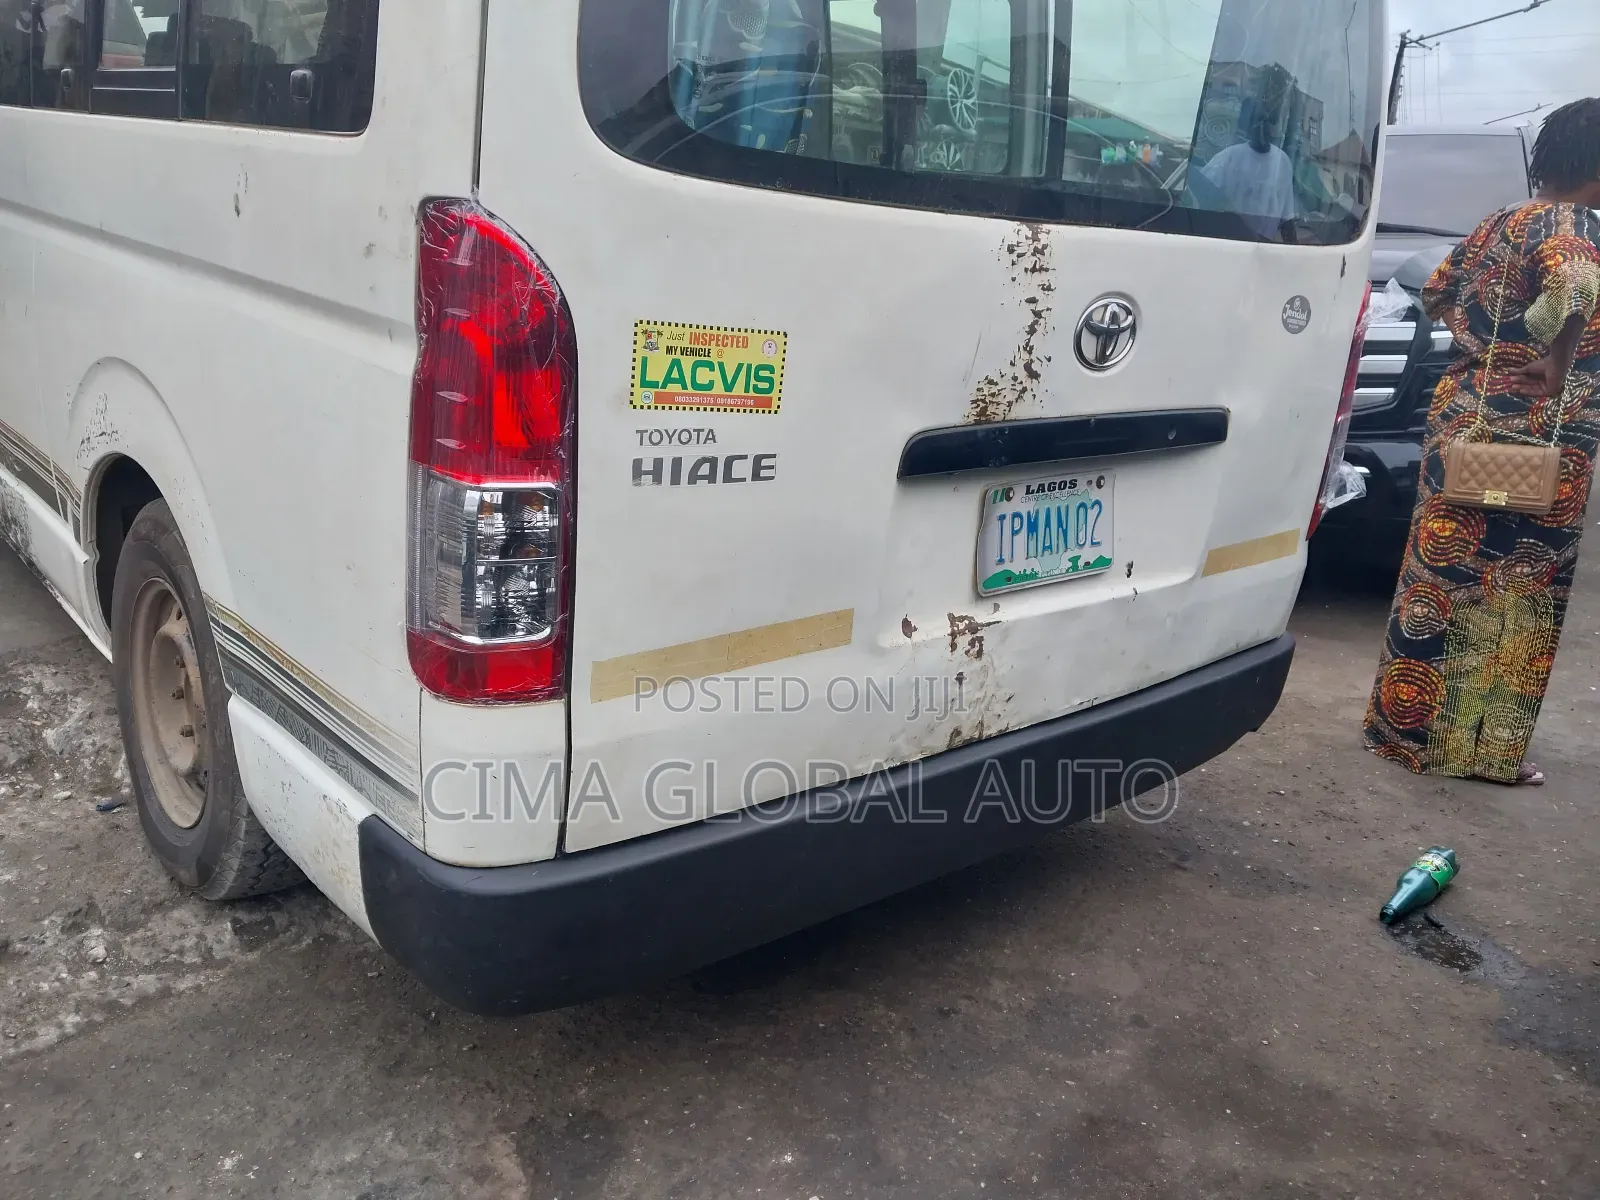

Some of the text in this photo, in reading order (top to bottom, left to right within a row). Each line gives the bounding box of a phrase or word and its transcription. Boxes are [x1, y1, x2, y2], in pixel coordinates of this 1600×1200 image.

[667, 330, 749, 349] Just INSPECTED
[665, 345, 679, 356] MY
[680, 346, 712, 358] VEHICLE
[639, 355, 776, 395] LACVIS
[635, 428, 718, 446] TOYOTA
[632, 453, 777, 487] HIACE
[1025, 479, 1078, 496] LAGOS
[1020, 493, 1040, 504] CENTRE
